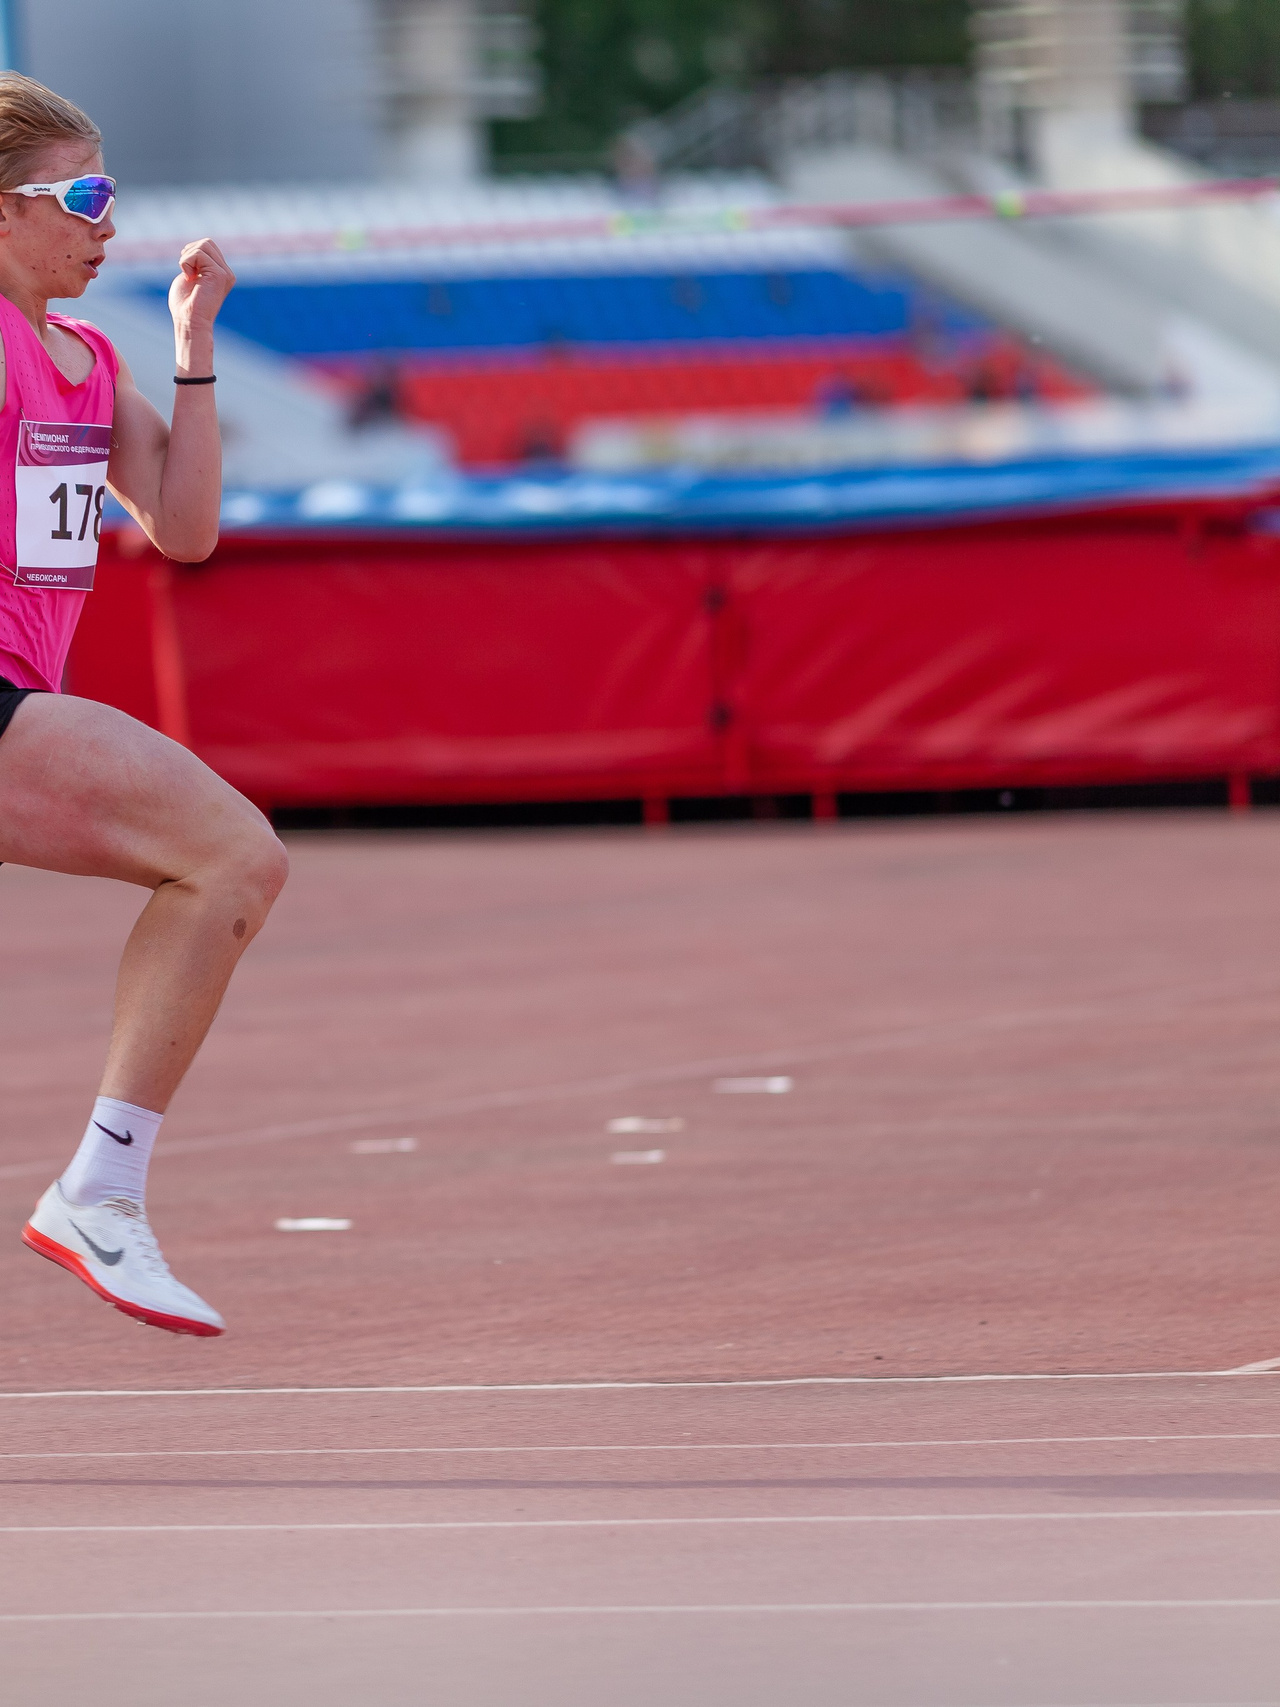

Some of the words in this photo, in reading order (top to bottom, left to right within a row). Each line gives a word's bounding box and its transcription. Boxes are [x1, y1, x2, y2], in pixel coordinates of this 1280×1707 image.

[31, 432, 69, 444] ЧЕМПИОНАТ
[70, 445, 104, 455] ФЕДЕРАЛЬНОГО
[26, 573, 68, 583] ЧЕБОКСАРЫ
